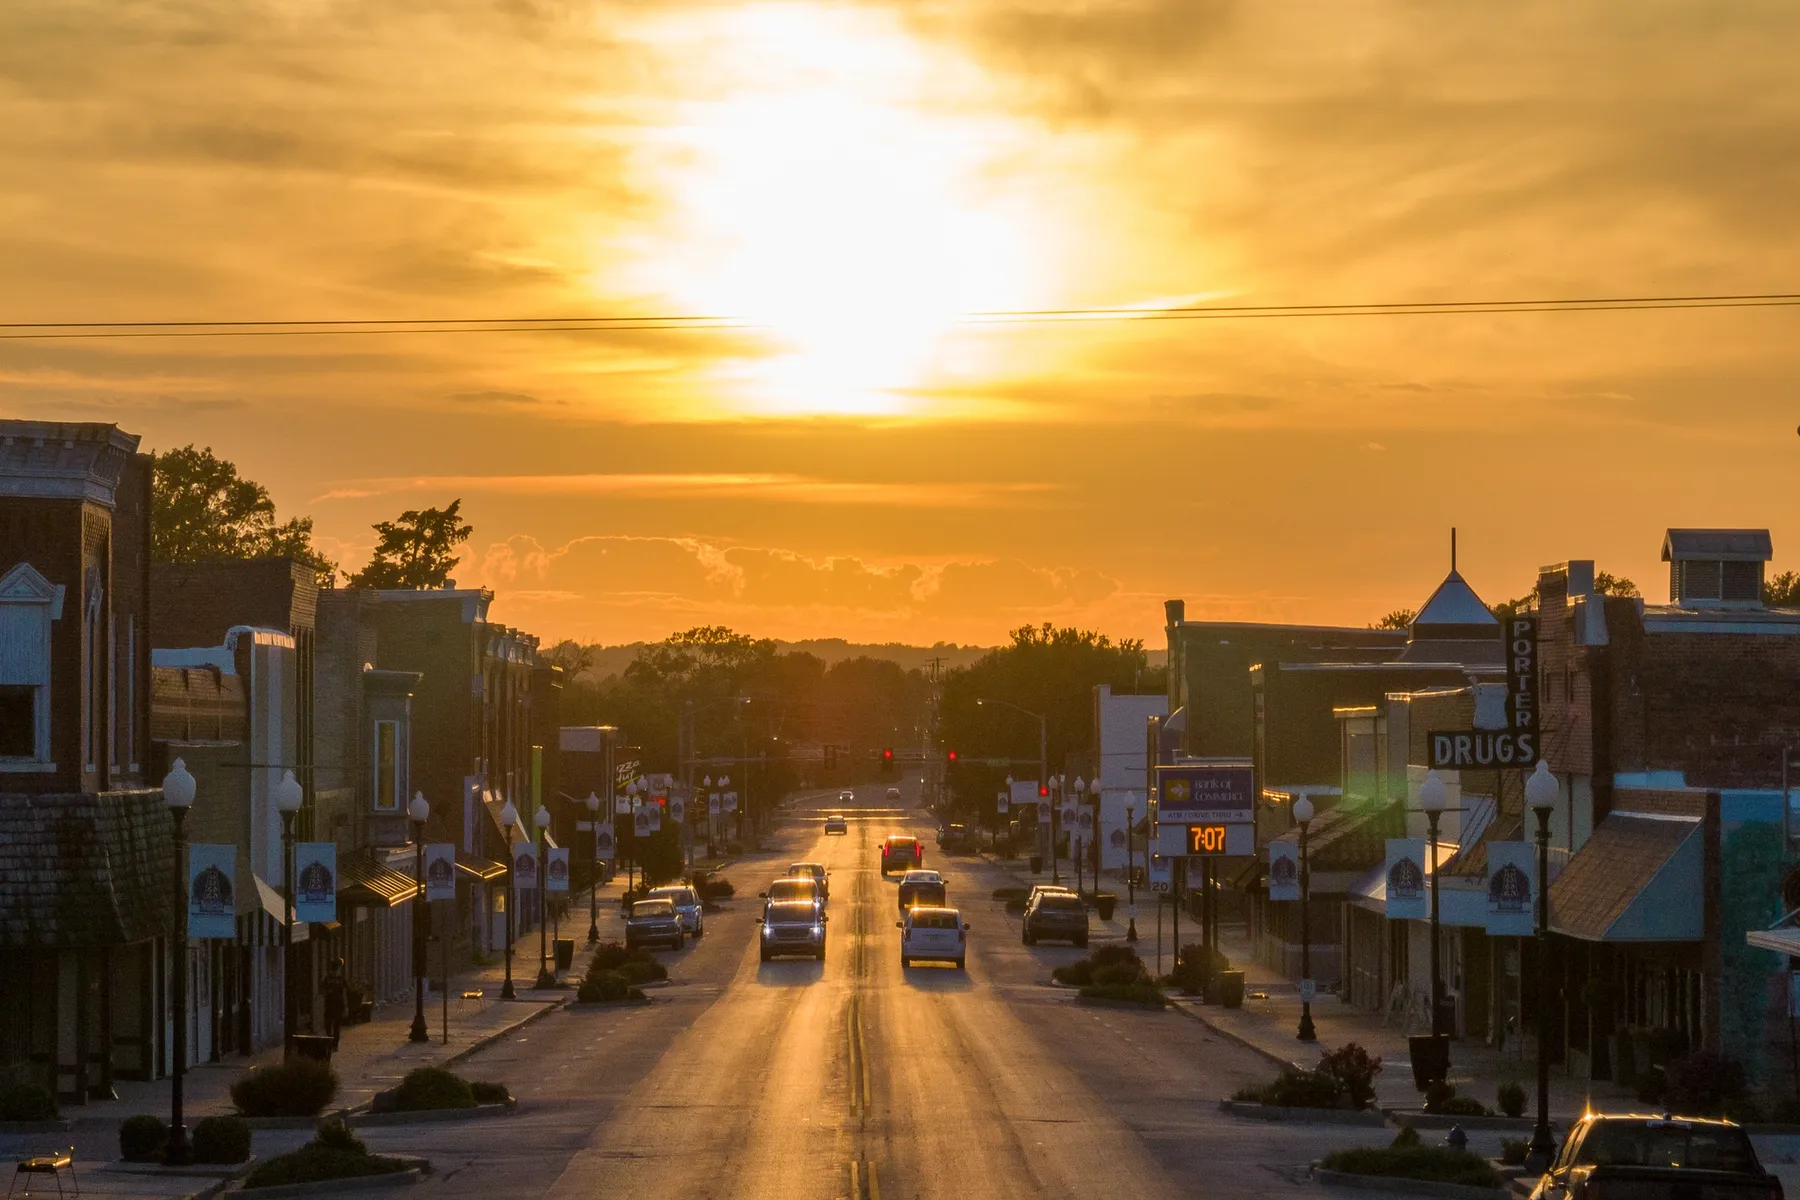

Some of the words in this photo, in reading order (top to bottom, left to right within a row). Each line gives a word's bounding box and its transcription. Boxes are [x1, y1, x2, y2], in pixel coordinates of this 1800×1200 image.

[1512, 620, 1532, 728] PORTER
[1434, 733, 1535, 766] DRUGS
[615, 760, 640, 773] izza
[1168, 811, 1183, 819] ATM
[1188, 811, 1210, 819] DRIVE
[1212, 811, 1232, 819] THRU
[1191, 827, 1225, 851] 7:07
[1151, 882, 1169, 892] 20
